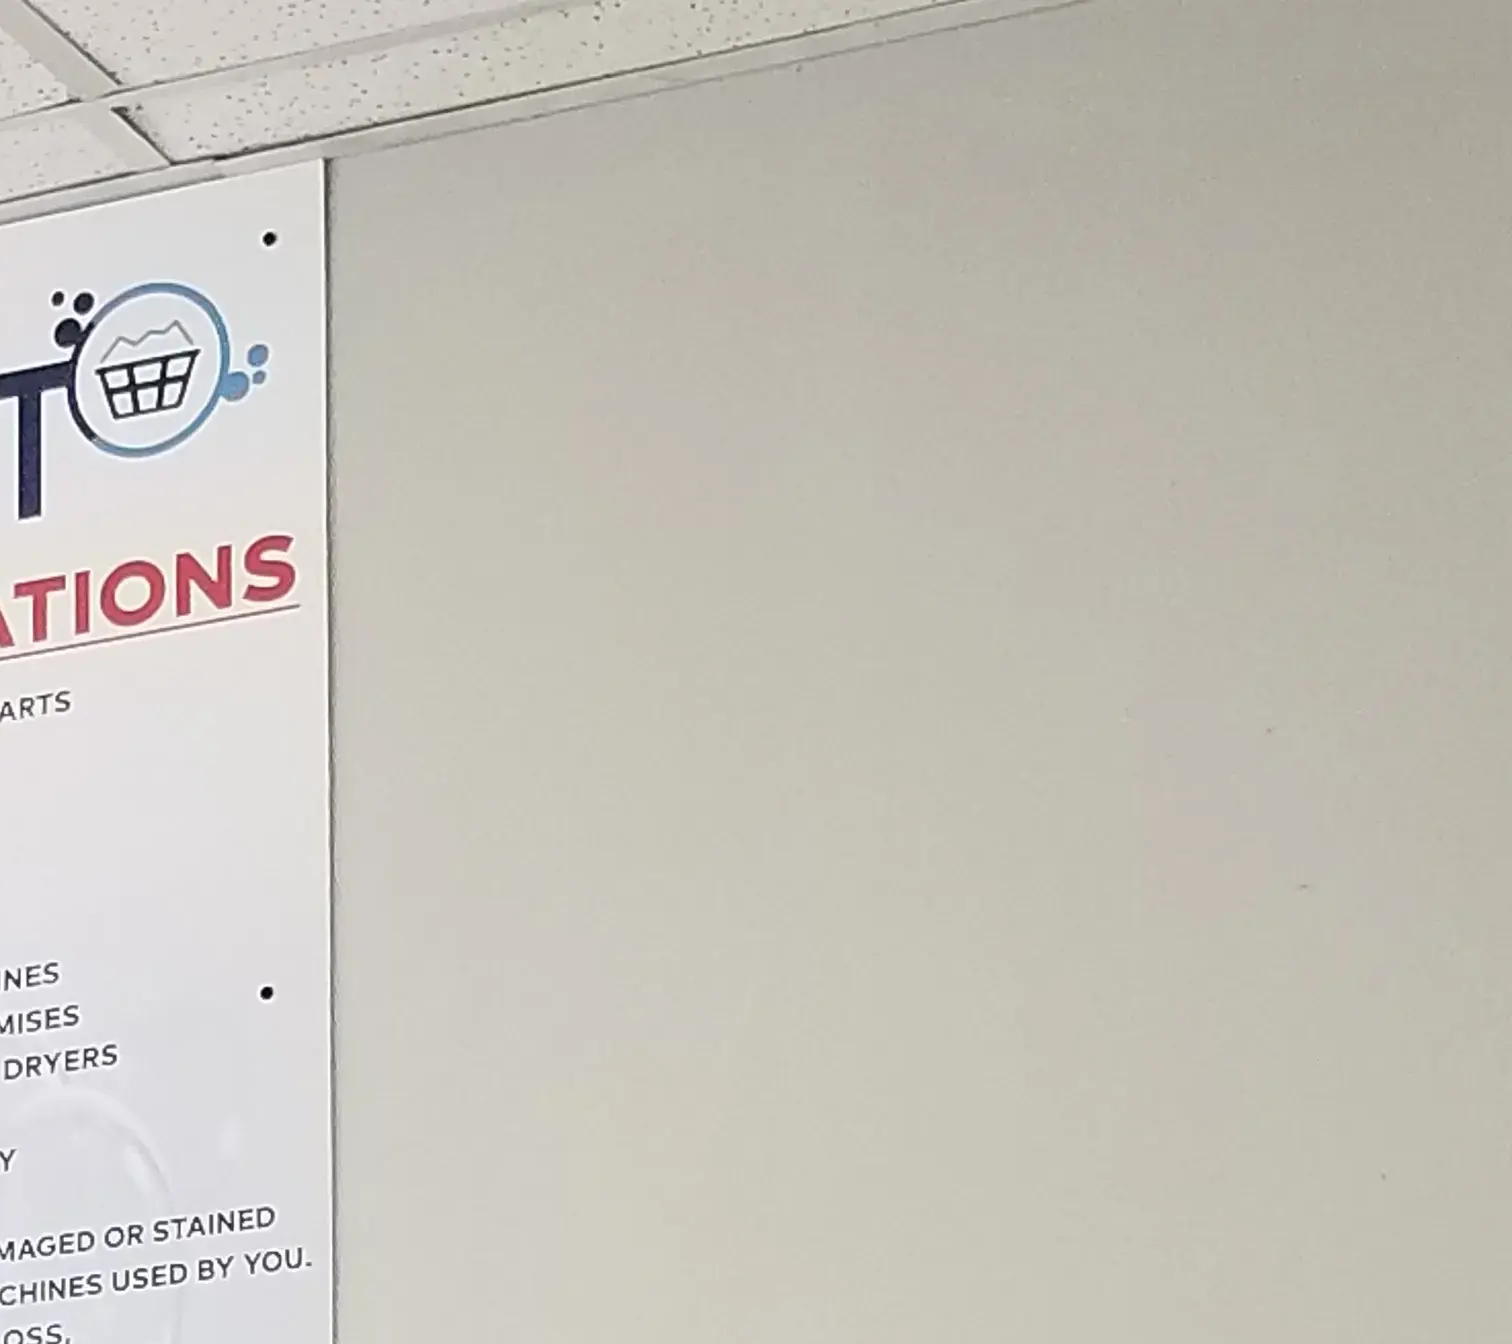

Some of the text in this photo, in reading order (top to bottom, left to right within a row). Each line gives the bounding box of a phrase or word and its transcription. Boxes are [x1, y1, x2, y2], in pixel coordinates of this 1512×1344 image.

[111, 1262, 188, 1293] USED
[197, 1254, 235, 1282] BY
[242, 1246, 313, 1276] YOU.
